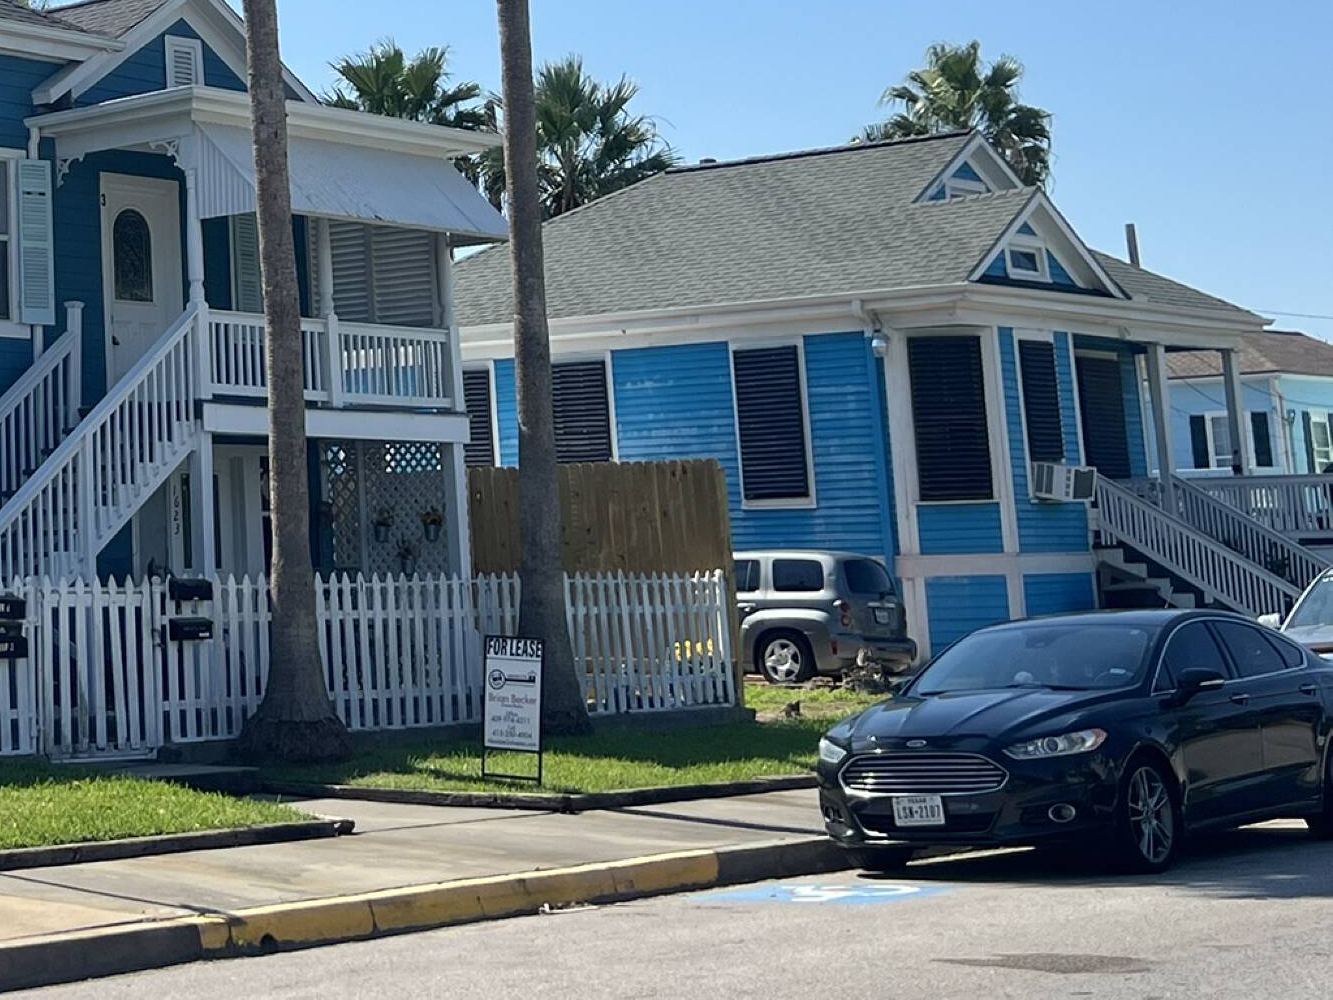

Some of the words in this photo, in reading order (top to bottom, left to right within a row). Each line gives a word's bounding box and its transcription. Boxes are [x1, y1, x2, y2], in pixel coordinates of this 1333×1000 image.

[487, 638, 507, 656] FOR
[509, 639, 542, 658] LEASE
[510, 694, 537, 705] Becker
